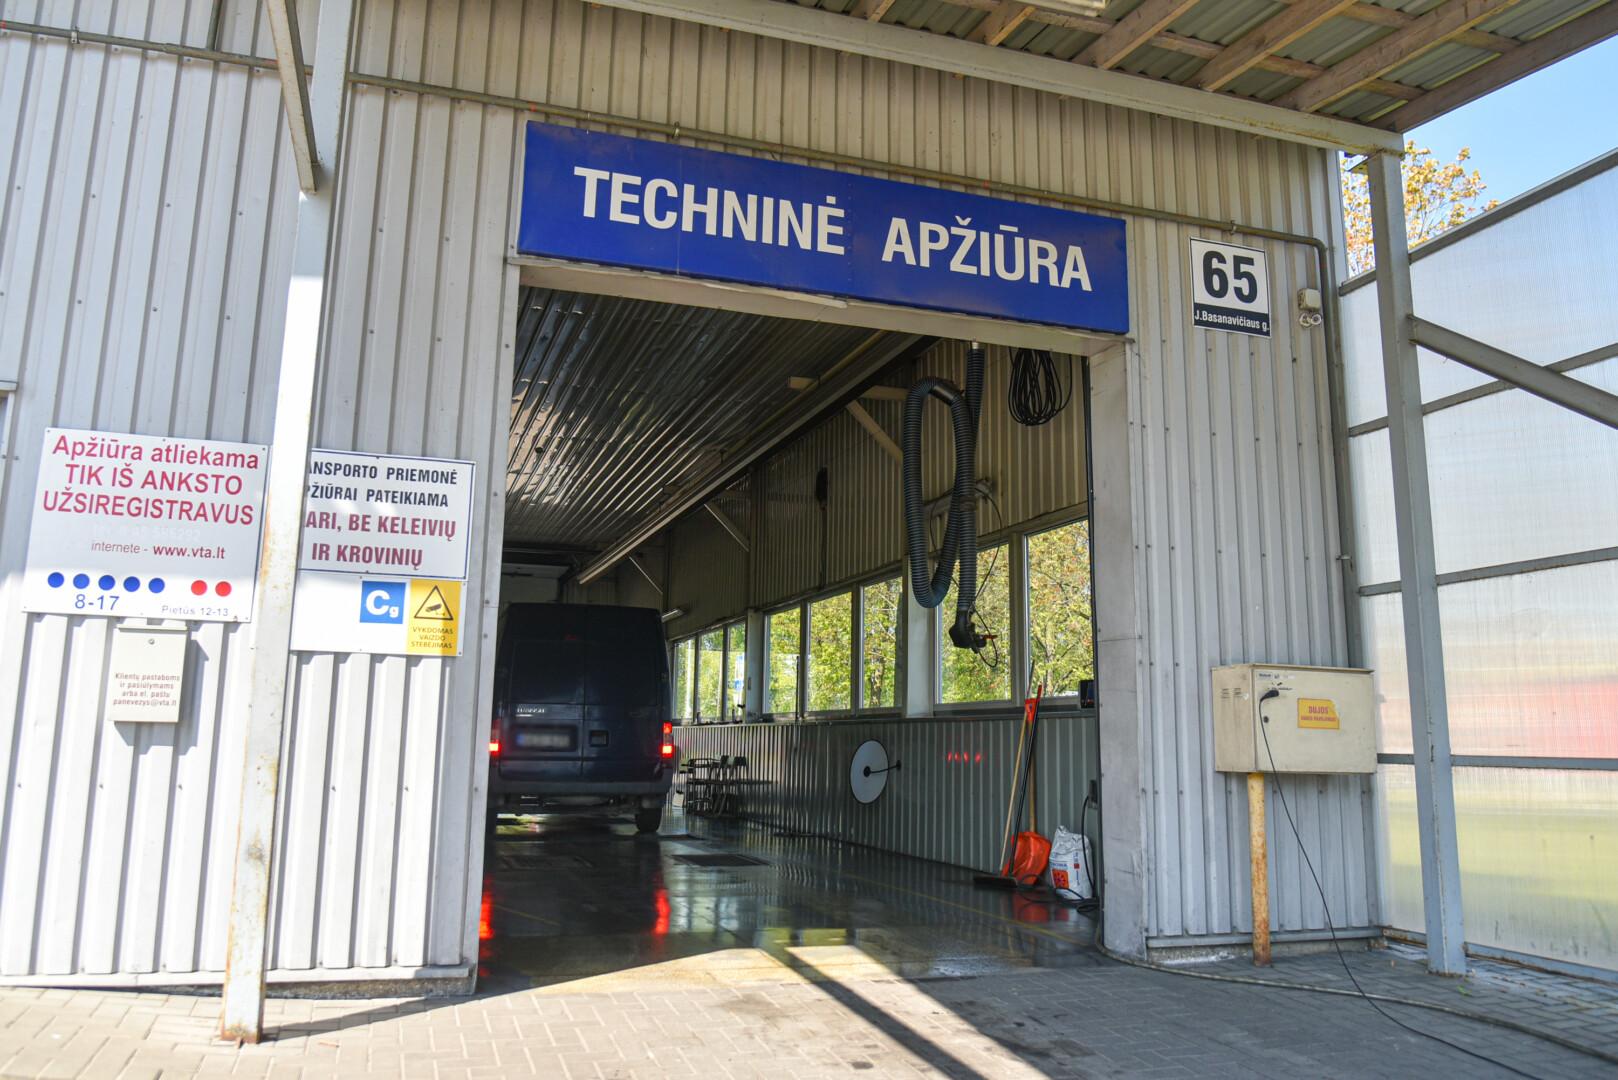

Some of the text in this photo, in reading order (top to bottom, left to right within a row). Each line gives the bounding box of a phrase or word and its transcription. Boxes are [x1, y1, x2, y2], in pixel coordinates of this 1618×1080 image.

[574, 166, 1093, 292] TECHNINĖ APŽIŪRA
[1203, 250, 1258, 304] 65
[1194, 310, 1260, 329] J.Basanavičiaus
[52, 435, 259, 470] Apžiūra atliekama
[66, 463, 243, 495] TIK IŠ ANKSTO
[386, 467, 458, 485] PRIEMONĖ
[43, 486, 254, 525] UŽSIREGISTRAVUS
[307, 482, 449, 507] ŽIŪRAI PATEIKIAMA
[348, 511, 372, 532] BE
[377, 515, 456, 541] KELEIVIŲ
[91, 540, 141, 554] internete
[153, 544, 226, 559] www.vta.lt
[311, 543, 423, 571] IR KROVINIŲ
[74, 593, 120, 611] 8-17
[200, 607, 230, 617] 12-13
[412, 626, 454, 635] VYKDOMAS
[419, 634, 446, 642] VAIZDO
[1308, 706, 1329, 714] DUJOS
